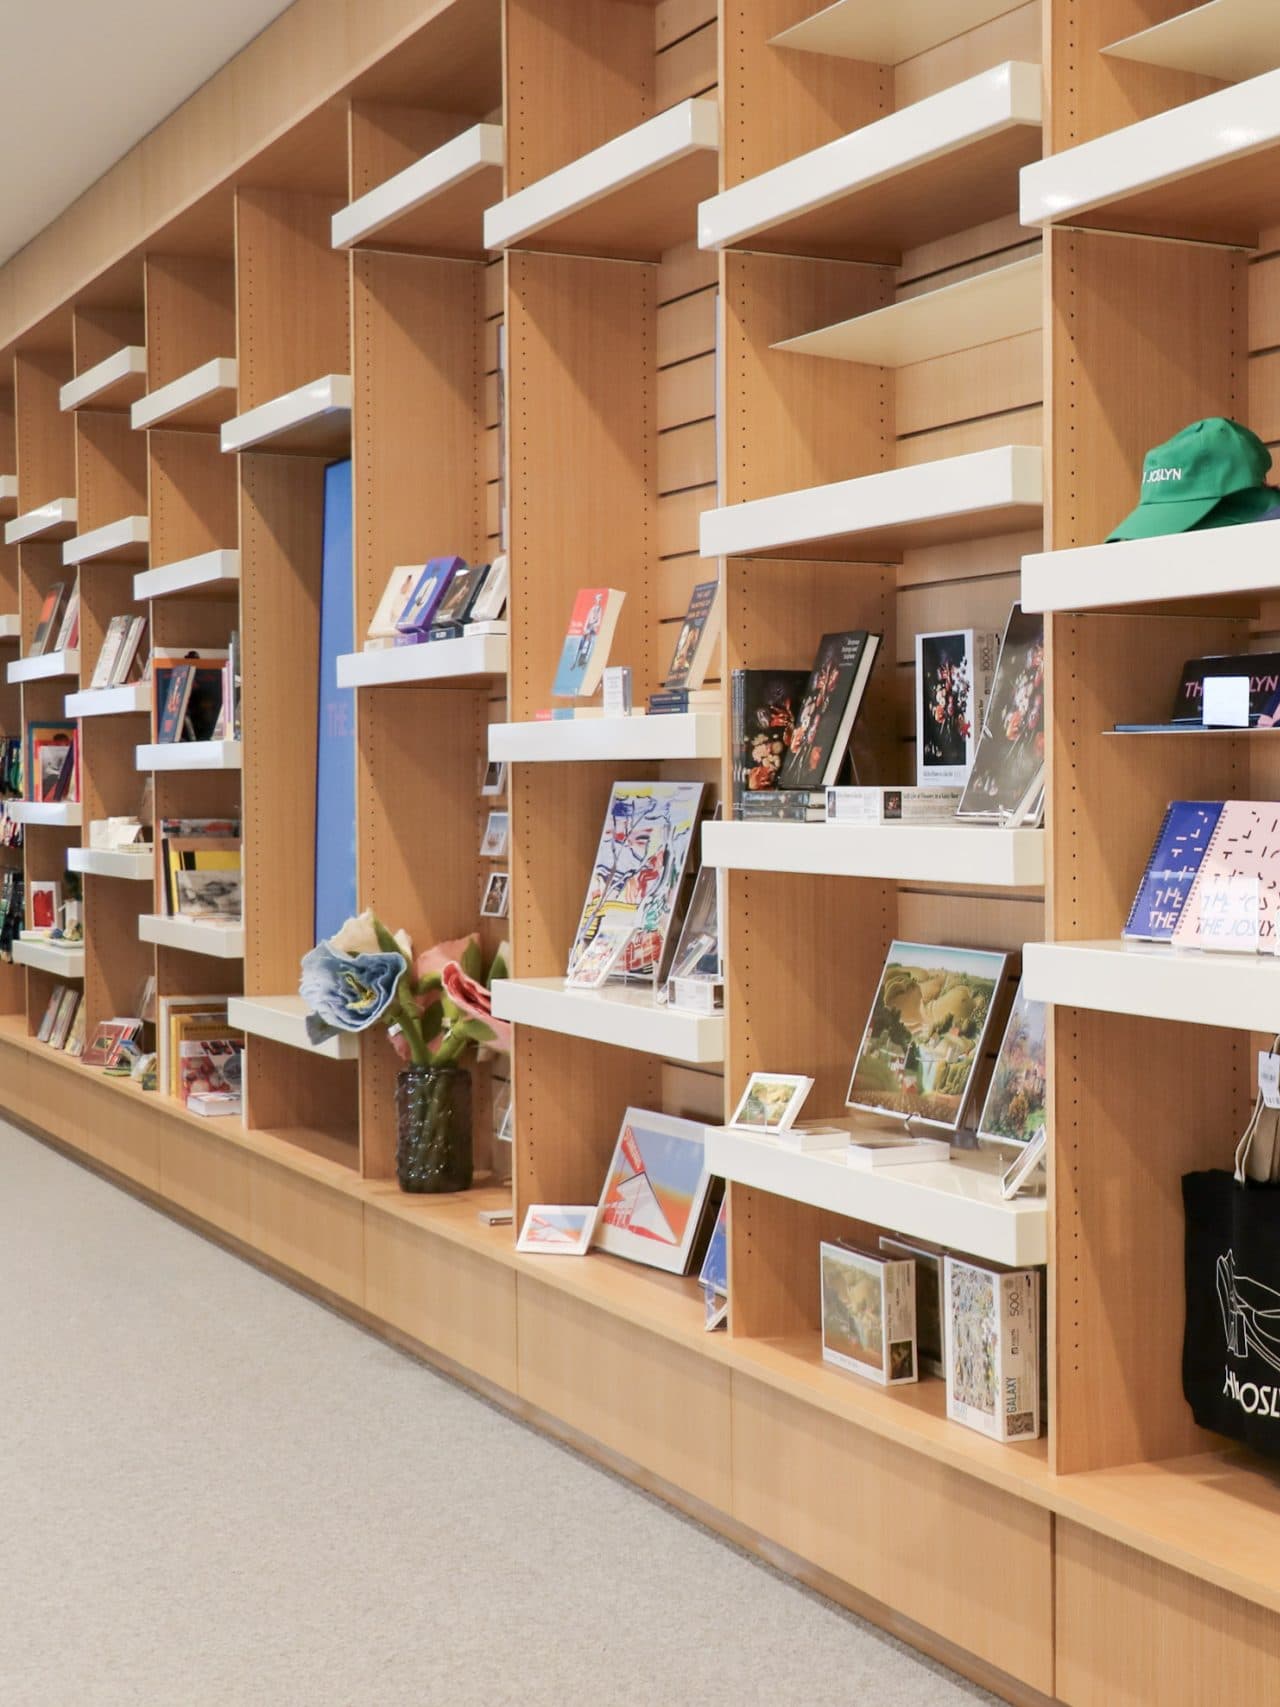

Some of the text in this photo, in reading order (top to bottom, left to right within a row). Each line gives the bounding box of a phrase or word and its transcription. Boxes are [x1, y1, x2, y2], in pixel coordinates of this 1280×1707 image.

[1185, 675, 1279, 699] TH LYN
[1149, 911, 1177, 930] THE
[1225, 918, 1277, 938] JOSLY
[1006, 1376, 1018, 1414] GALAXY
